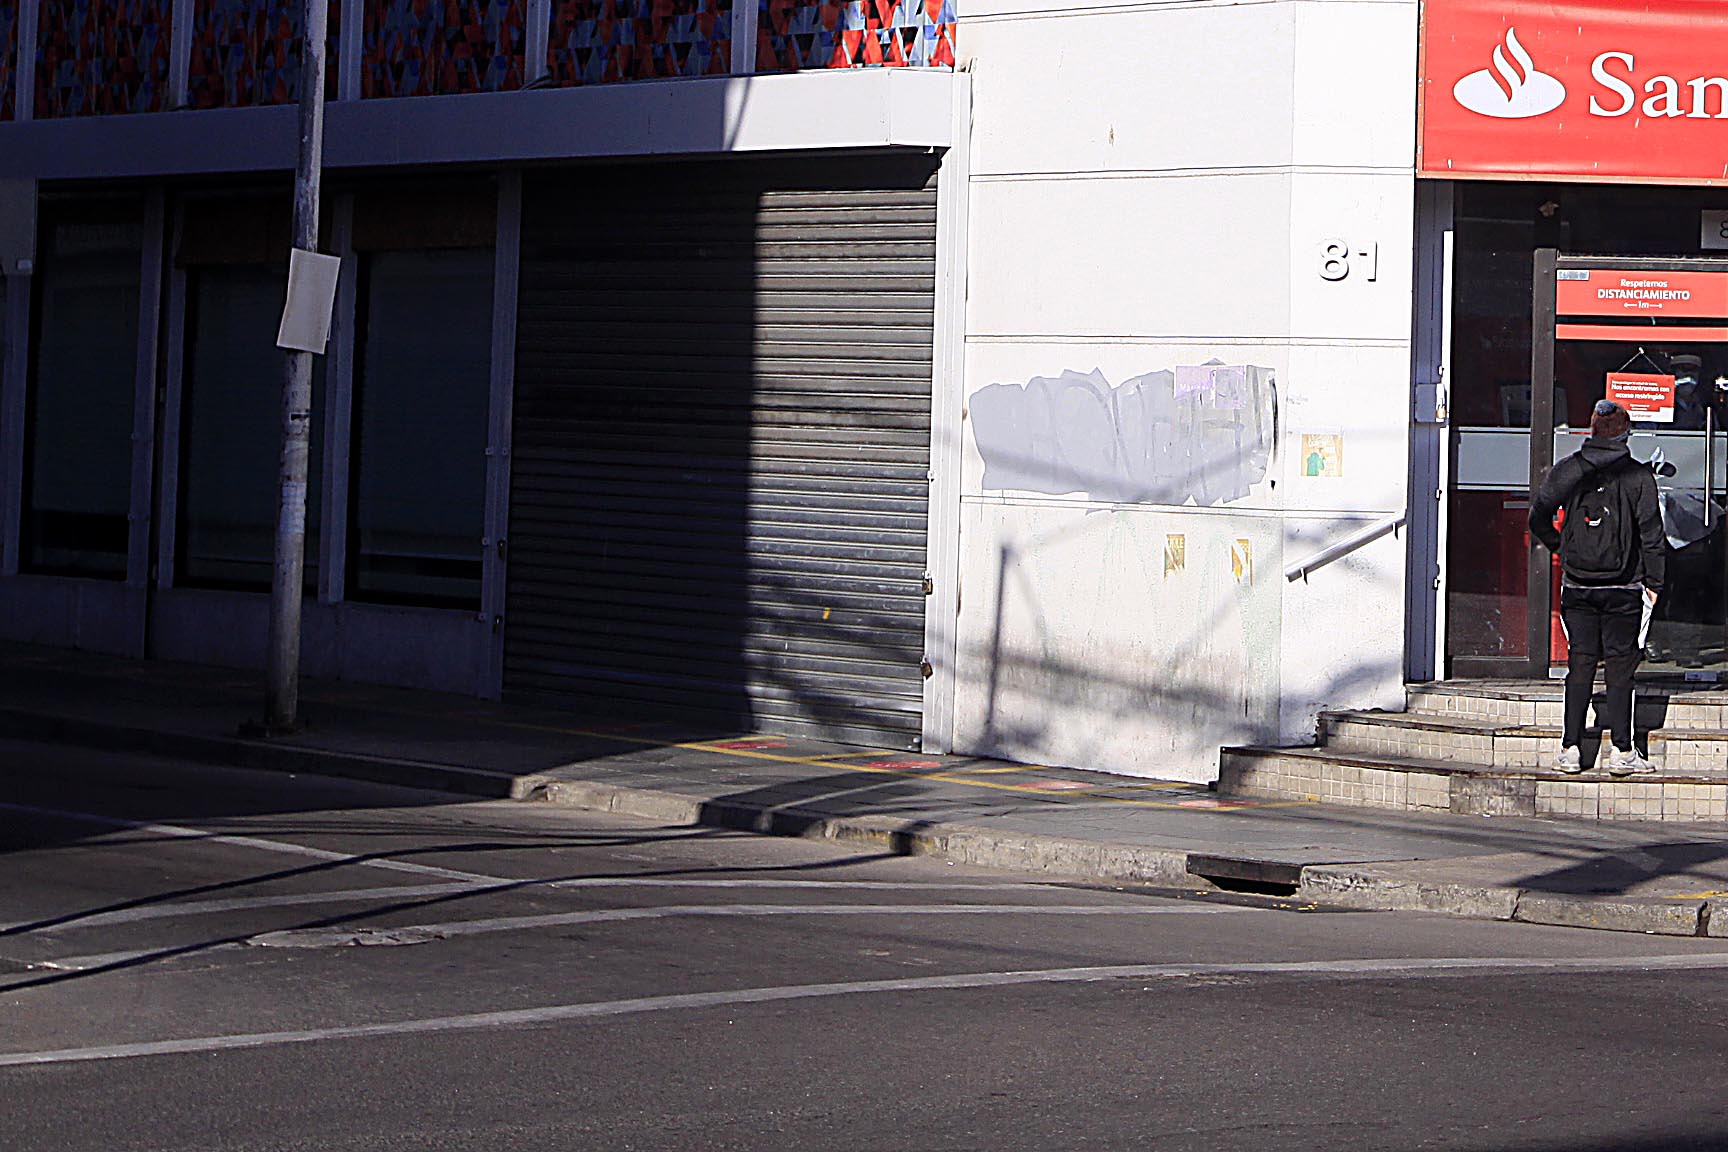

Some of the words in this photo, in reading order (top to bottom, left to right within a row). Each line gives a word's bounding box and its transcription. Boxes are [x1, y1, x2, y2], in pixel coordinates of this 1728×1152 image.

[1318, 238, 1378, 282] 81
[1620, 278, 1668, 288] Respetemos
[1597, 288, 1691, 300] DISTANCIAMIENTO
